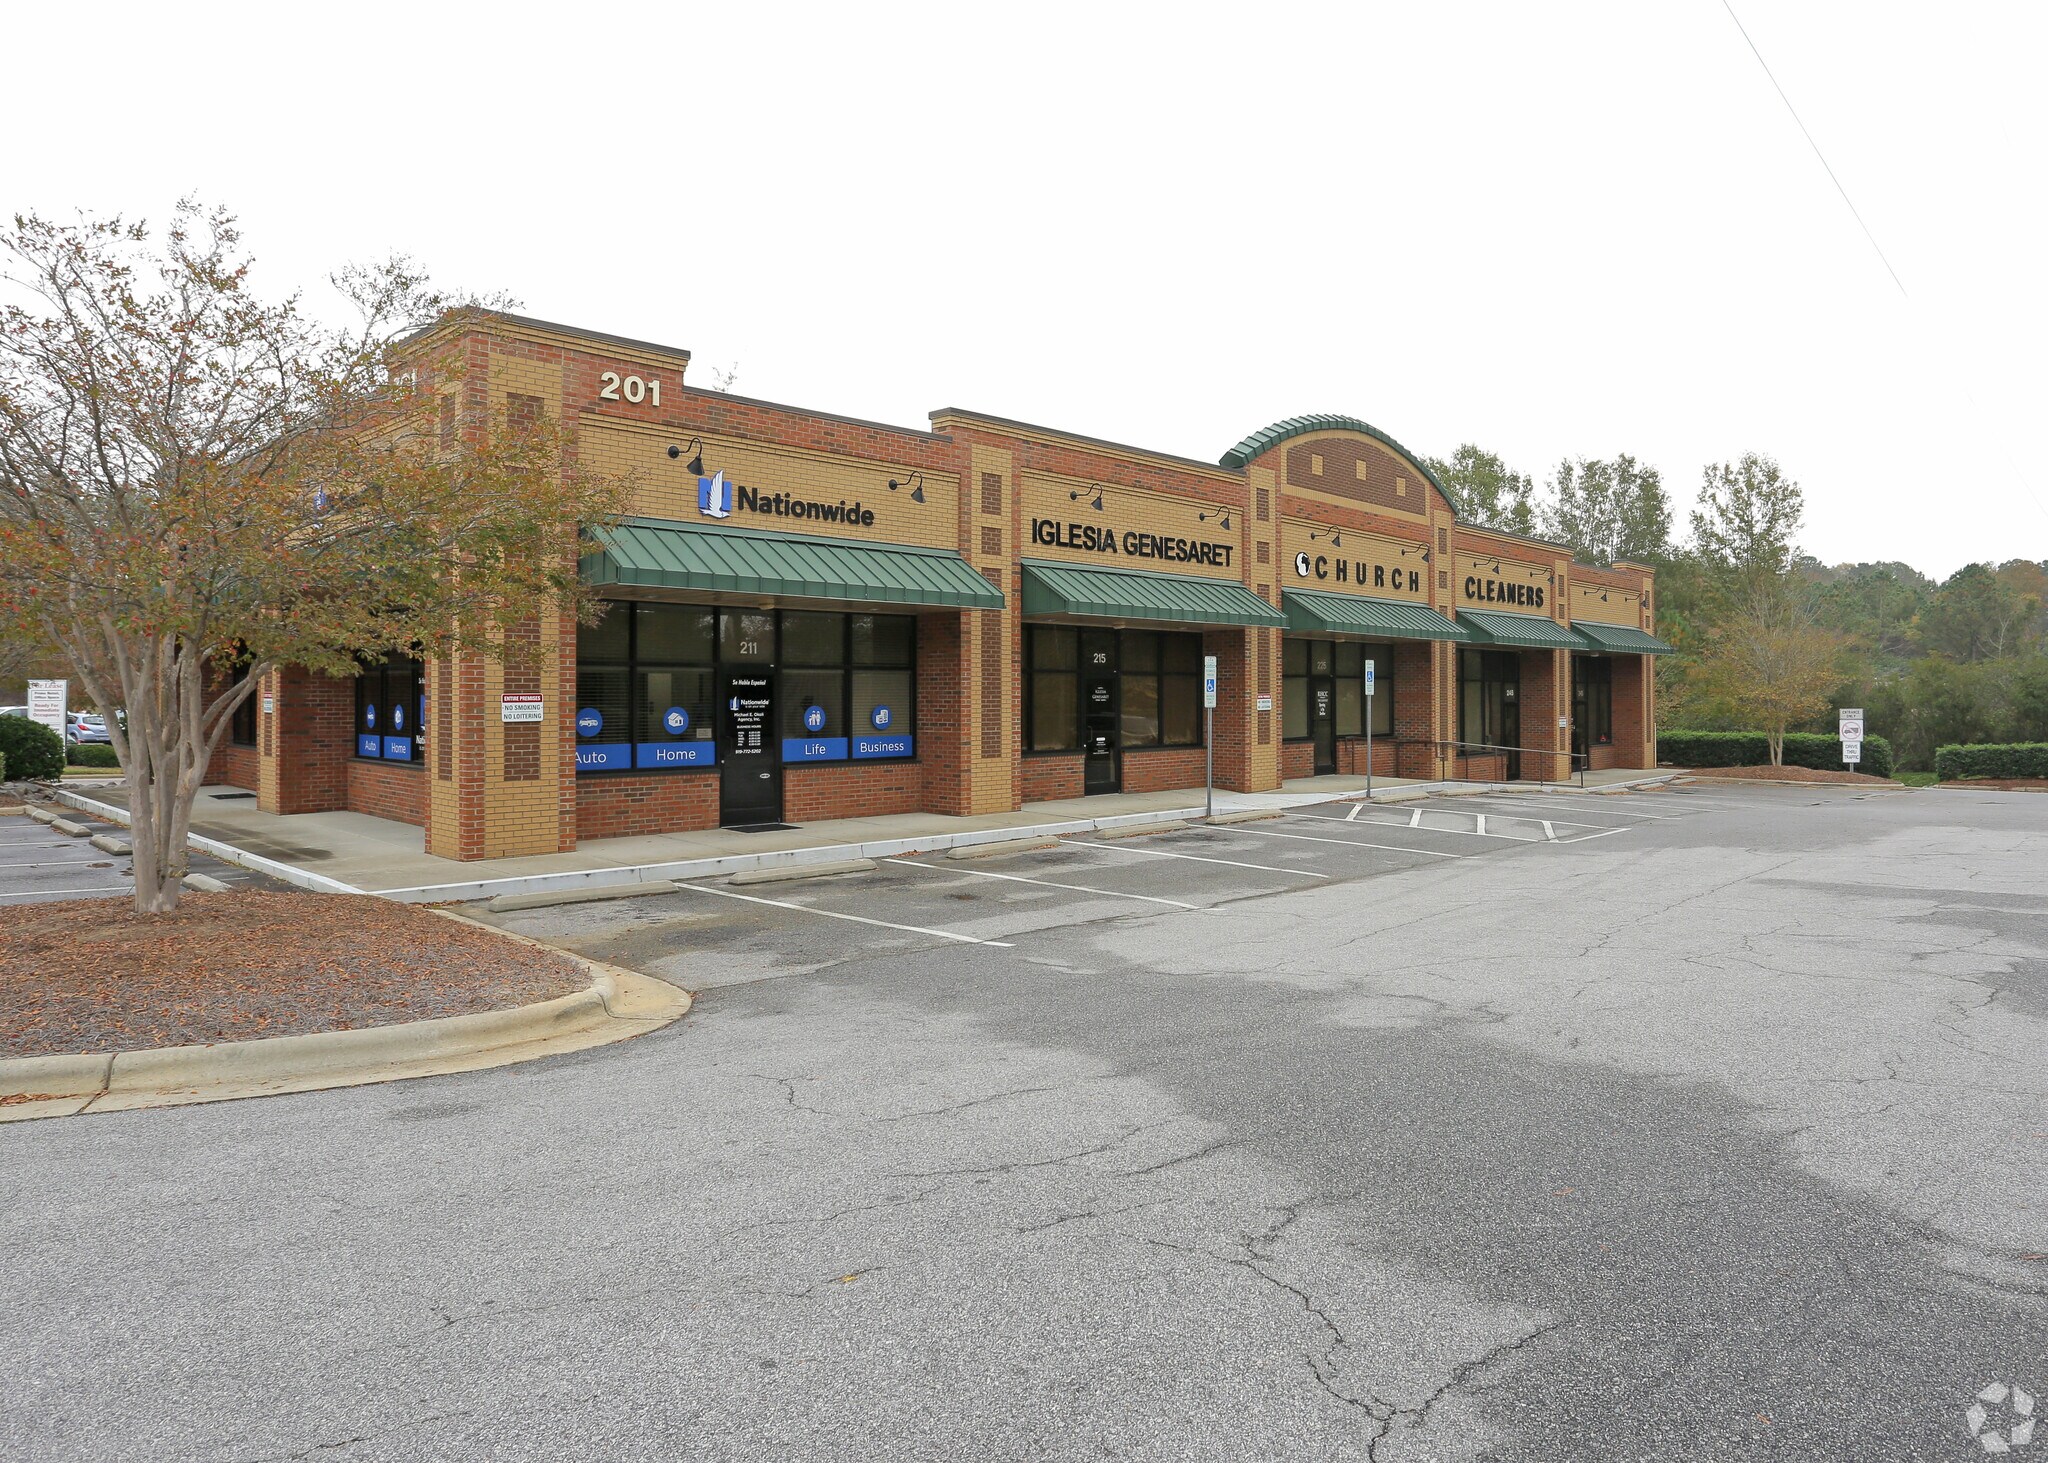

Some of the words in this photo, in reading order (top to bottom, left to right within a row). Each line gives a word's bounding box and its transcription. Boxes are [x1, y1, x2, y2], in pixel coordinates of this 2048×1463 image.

[600, 371, 661, 407] 201
[738, 486, 875, 527] Nationwide
[1032, 518, 1118, 553] IGLESIA
[1123, 531, 1234, 567] GENESARET
[1315, 556, 1419, 592] CHURCH
[1465, 576, 1544, 608] CLEANERS
[740, 641, 757, 654] 211
[1093, 653, 1107, 664] 215
[365, 740, 376, 750] Auto
[392, 743, 406, 754] Home
[804, 743, 826, 755] Life
[859, 741, 905, 753] Business
[574, 751, 607, 764] Auto
[656, 749, 696, 761] Home
